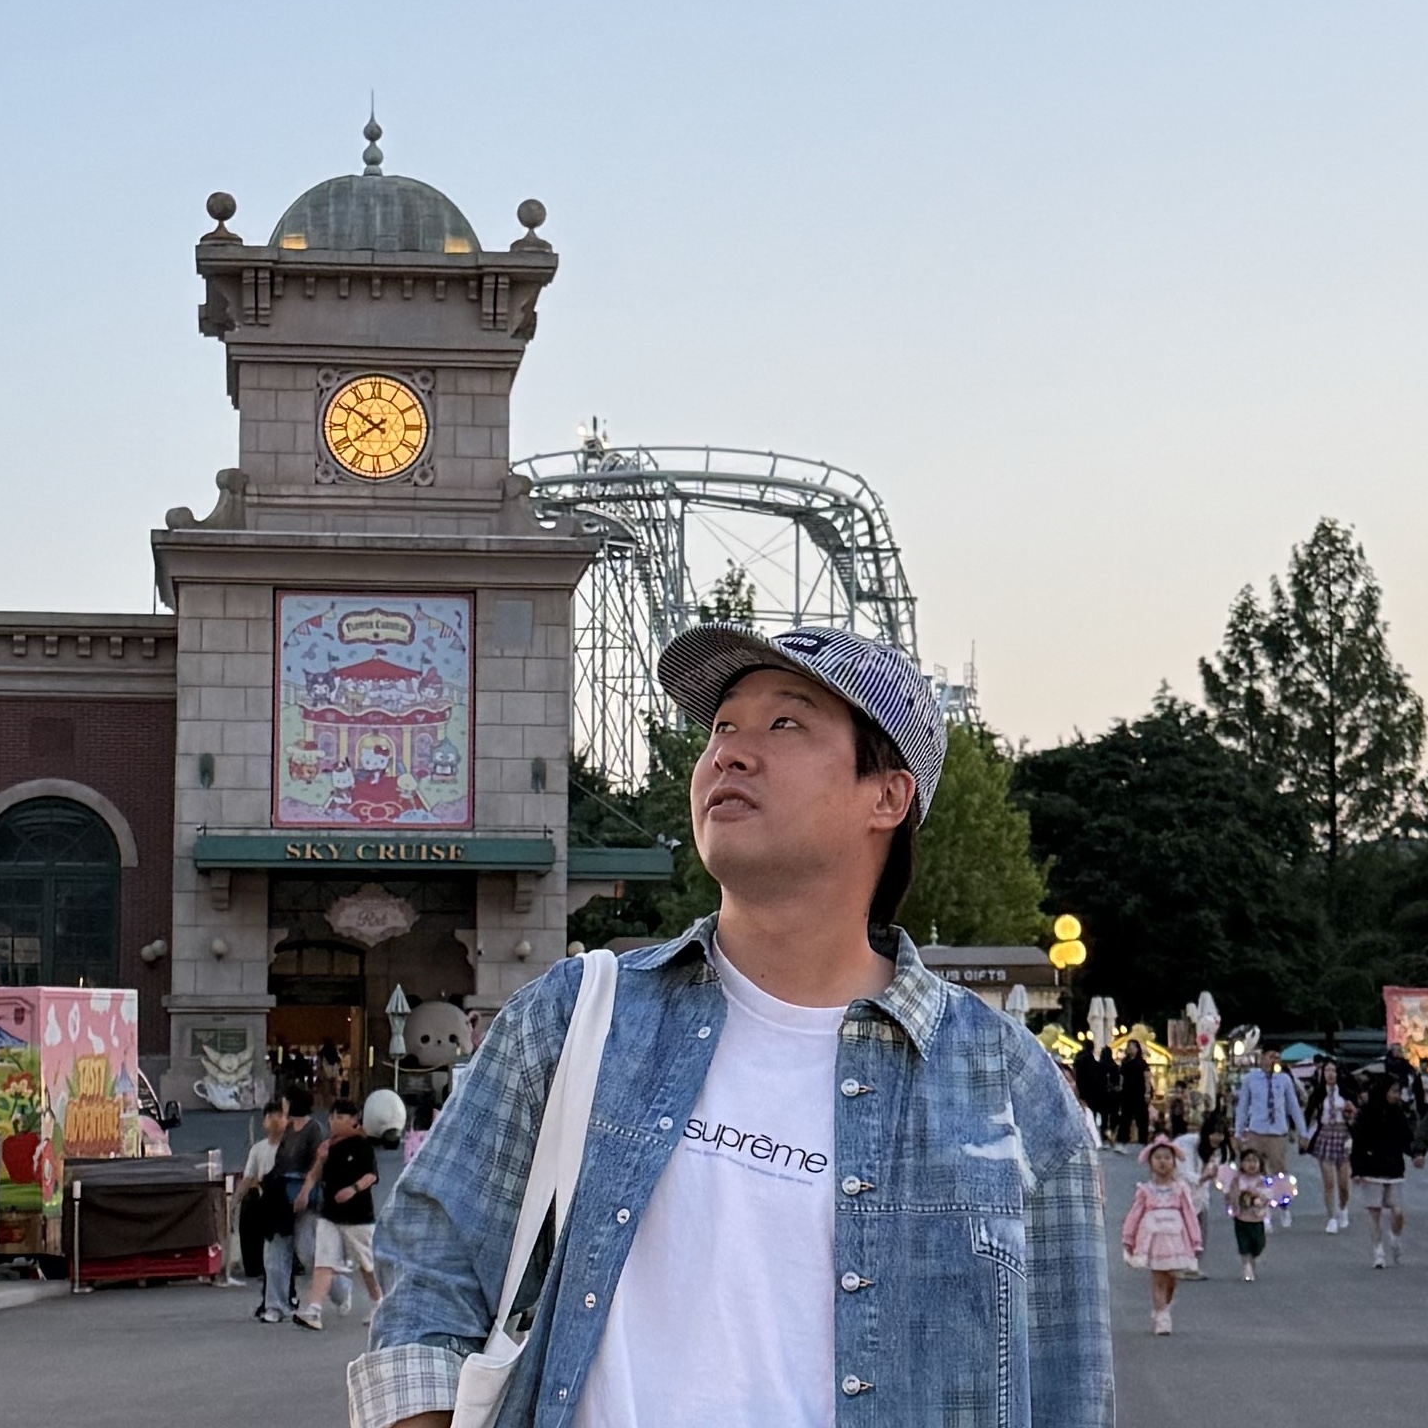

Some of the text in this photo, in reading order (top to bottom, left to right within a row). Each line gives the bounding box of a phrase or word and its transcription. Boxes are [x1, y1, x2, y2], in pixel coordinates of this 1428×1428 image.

[285, 842, 466, 861] SKY CRUISE
[963, 969, 1007, 982] GIFTS
